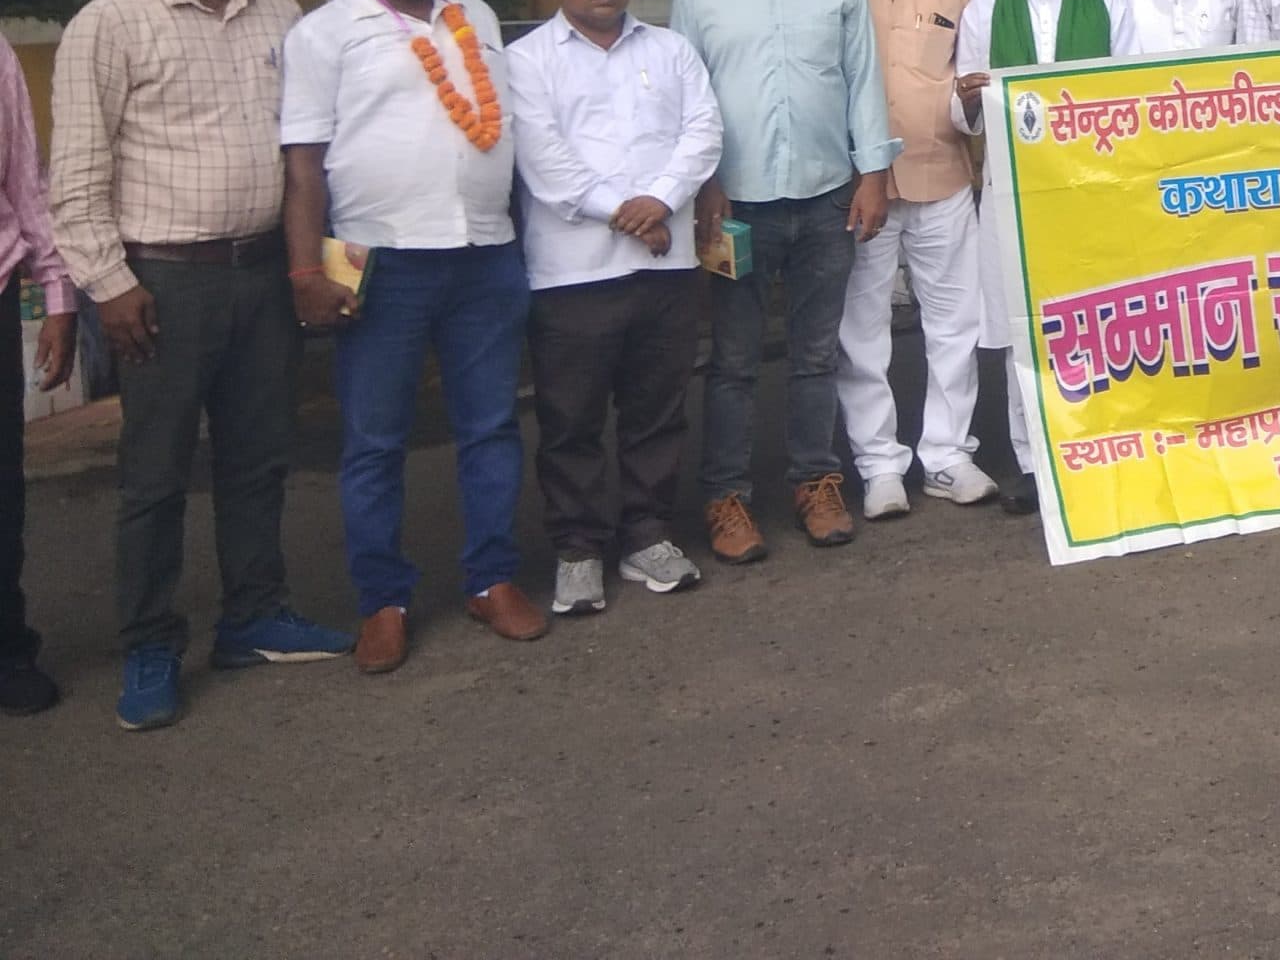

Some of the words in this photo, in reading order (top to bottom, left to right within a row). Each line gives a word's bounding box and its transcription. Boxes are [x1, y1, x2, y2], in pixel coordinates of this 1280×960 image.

[1049, 91, 1140, 153] सेन्ट्रल
[1042, 255, 1259, 402] सम्मान
[1061, 431, 1143, 471] स्थान
